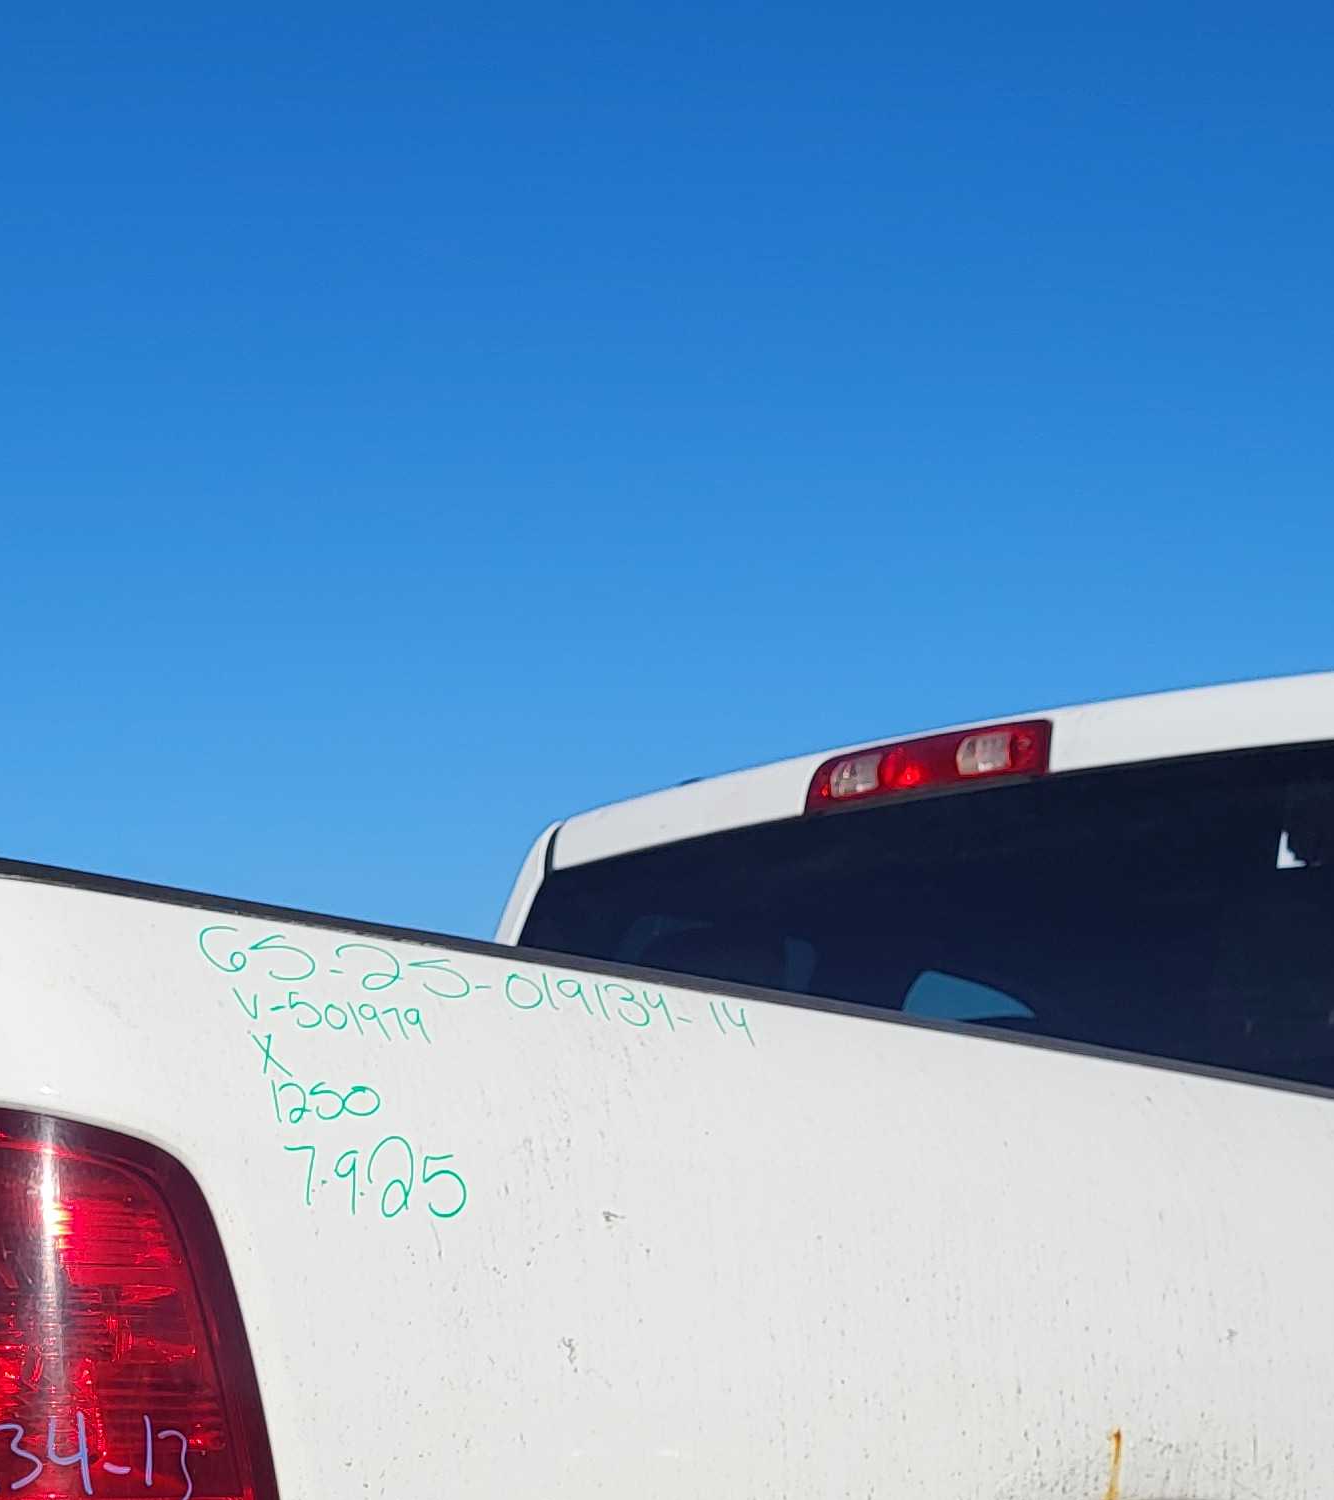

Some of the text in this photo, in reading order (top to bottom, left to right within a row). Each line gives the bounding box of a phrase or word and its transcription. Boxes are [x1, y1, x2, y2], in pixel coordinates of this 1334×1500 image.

[232, 987, 432, 1044] V-501979
[251, 1034, 293, 1077] X
[271, 1080, 381, 1124] 1250
